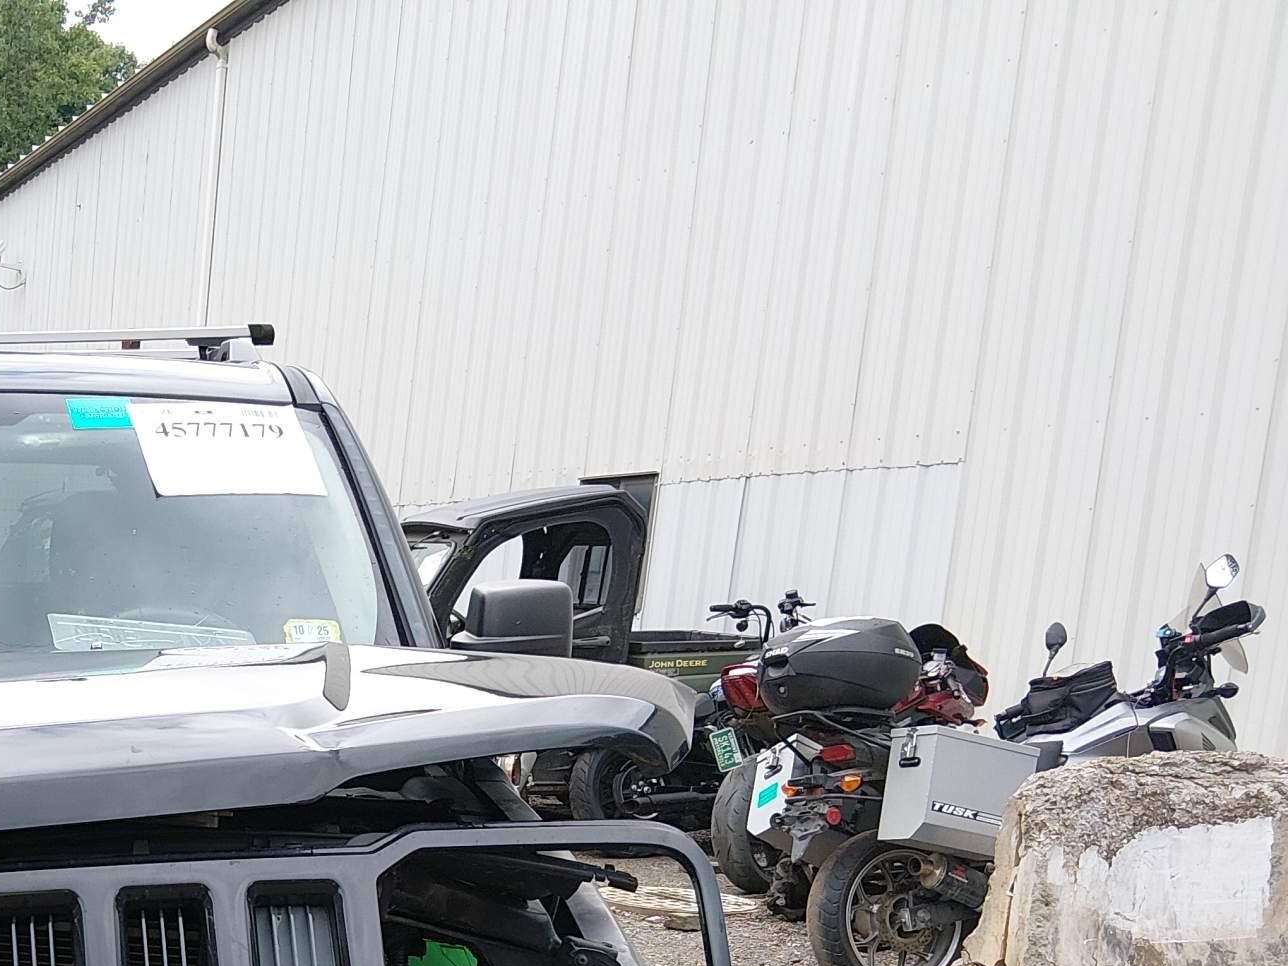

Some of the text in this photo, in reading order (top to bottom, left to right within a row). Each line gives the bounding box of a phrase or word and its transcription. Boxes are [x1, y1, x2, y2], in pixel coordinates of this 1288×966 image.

[154, 421, 284, 438] 45777179
[293, 624, 329, 636] 10 25
[648, 659, 708, 669] JOHN DEERE
[717, 734, 734, 765] SK143
[932, 801, 977, 819] TUSK
